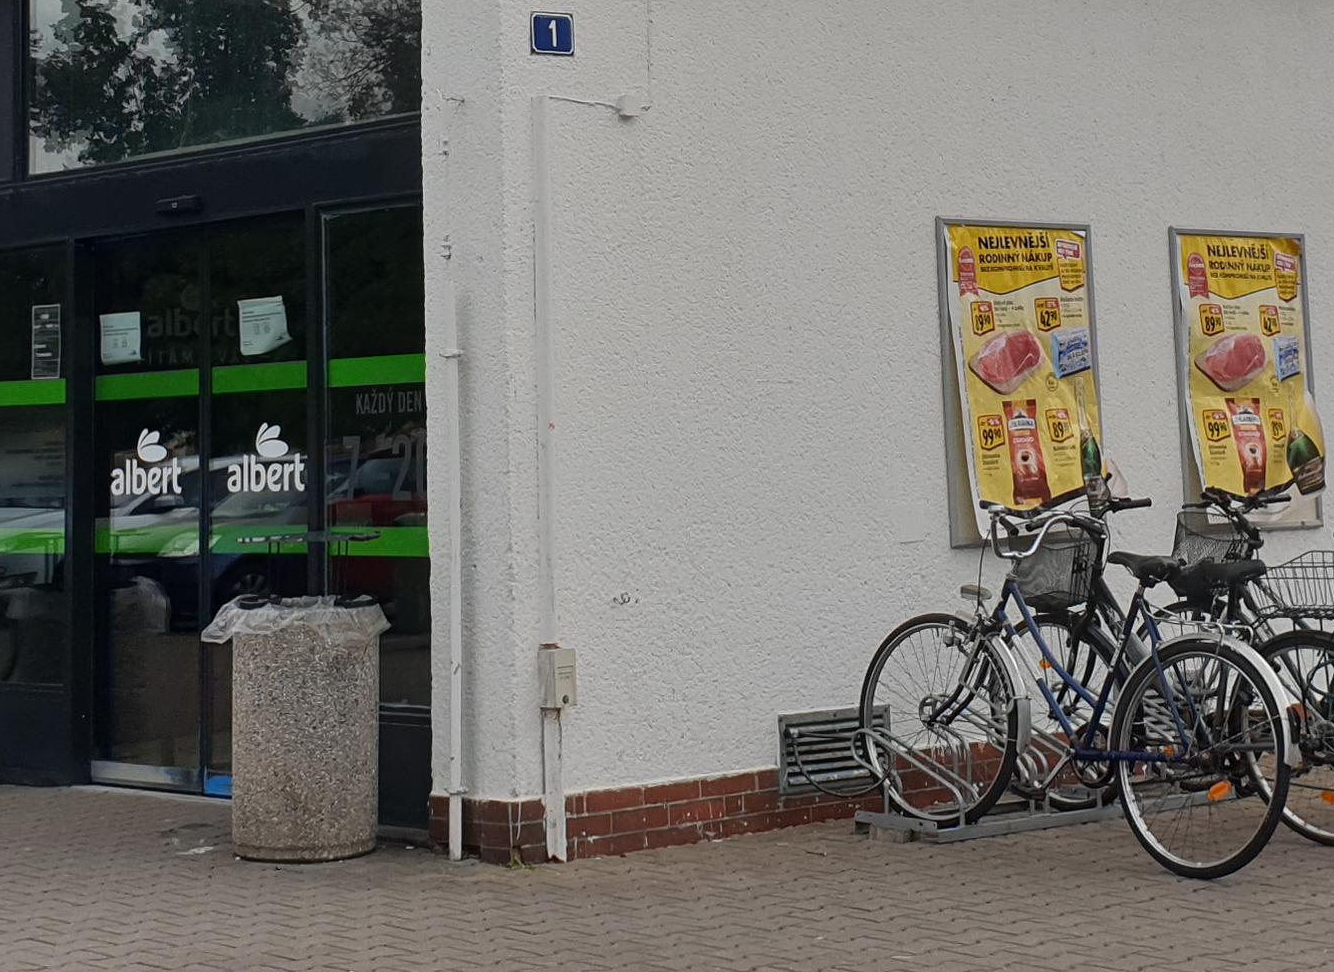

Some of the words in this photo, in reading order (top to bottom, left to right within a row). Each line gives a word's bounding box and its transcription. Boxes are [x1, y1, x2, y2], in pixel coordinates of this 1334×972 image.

[548, 19, 557, 47] 1
[978, 231, 1051, 250] NEJLEVNĚJŠÍ
[979, 250, 1020, 264] RODINNÝ
[1021, 250, 1053, 263] NÁKUP
[355, 387, 394, 415] KAŽDÝ
[397, 390, 422, 414] DEN
[110, 456, 183, 496] albert
[227, 452, 306, 493] albert
